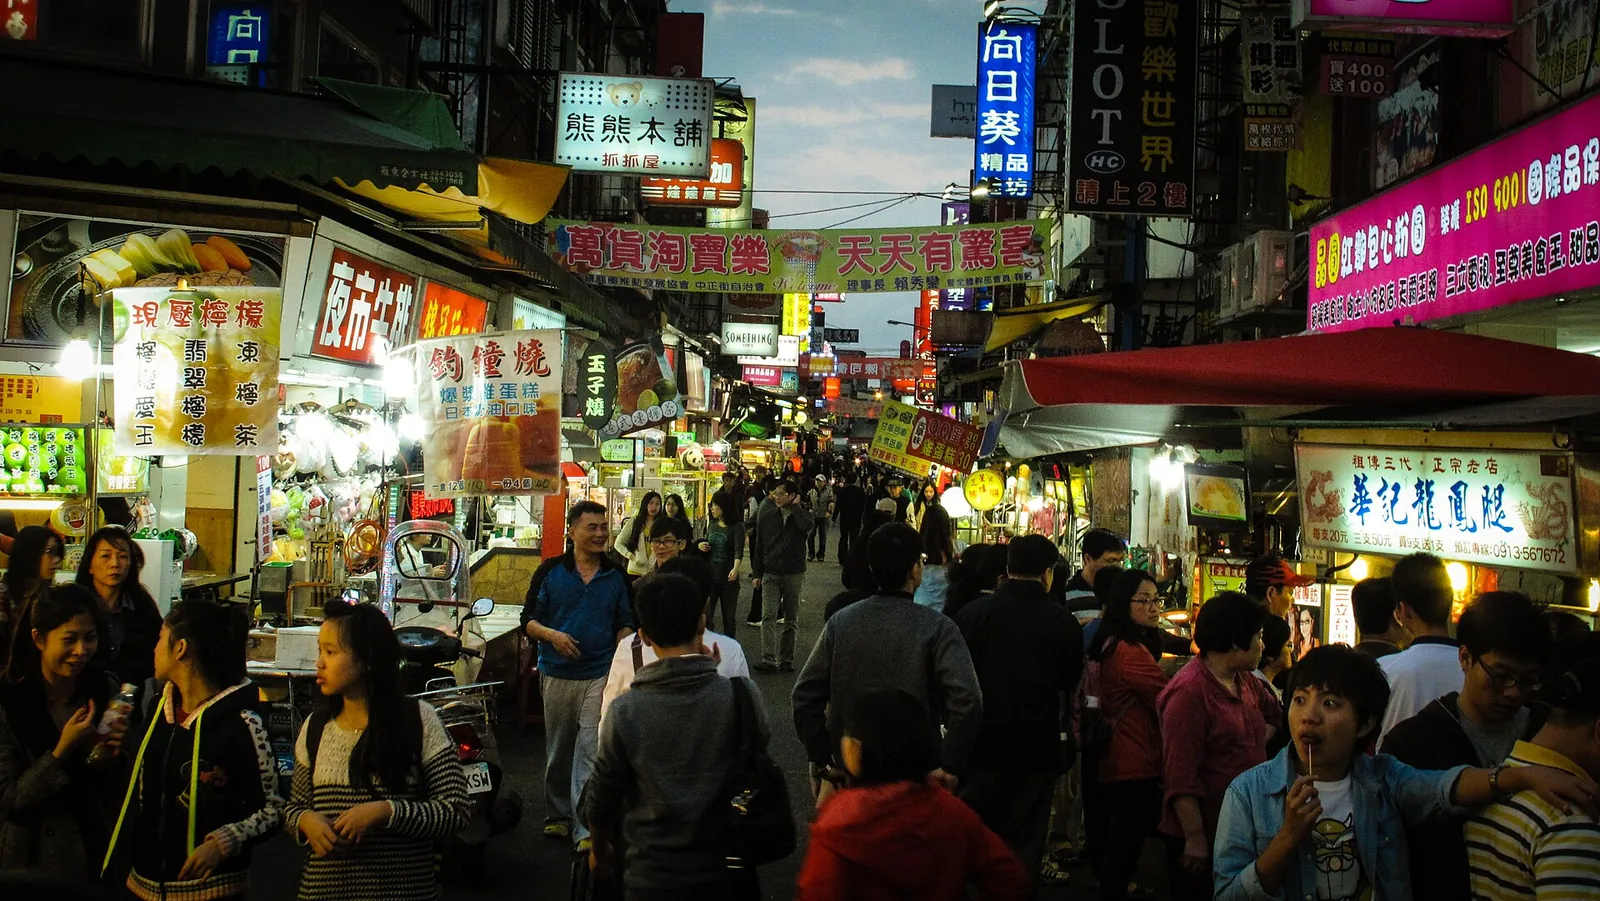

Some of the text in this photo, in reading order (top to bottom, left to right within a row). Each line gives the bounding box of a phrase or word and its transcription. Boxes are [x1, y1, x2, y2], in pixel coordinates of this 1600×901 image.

[980, 29, 1022, 146] 向日葵
[1091, 0, 1125, 145] LOT
[1140, 1, 1179, 173] 歡樂世界
[565, 113, 703, 147] 熊熊本舖
[602, 153, 660, 169] 抓抓屋
[981, 153, 1028, 172] 精品
[1091, 155, 1119, 169] HC
[1075, 179, 1187, 208] 請上2樓
[1465, 184, 1488, 224] ISO
[565, 225, 1034, 276] 萬貨淘寶樂 天天有驚喜
[695, 282, 766, 292] 中正街自治會
[847, 279, 886, 292] 理事長
[132, 299, 265, 329] 現壓檸檬
[725, 331, 772, 345] SOMETHING
[182, 339, 207, 446] 翡翠檸檬
[235, 340, 259, 447] 凍檸茶
[586, 354, 605, 417] 玉子燒
[1352, 455, 1499, 475] 祖傳三代 正宗老店
[1349, 473, 1514, 533] 華記龍鳳腿
